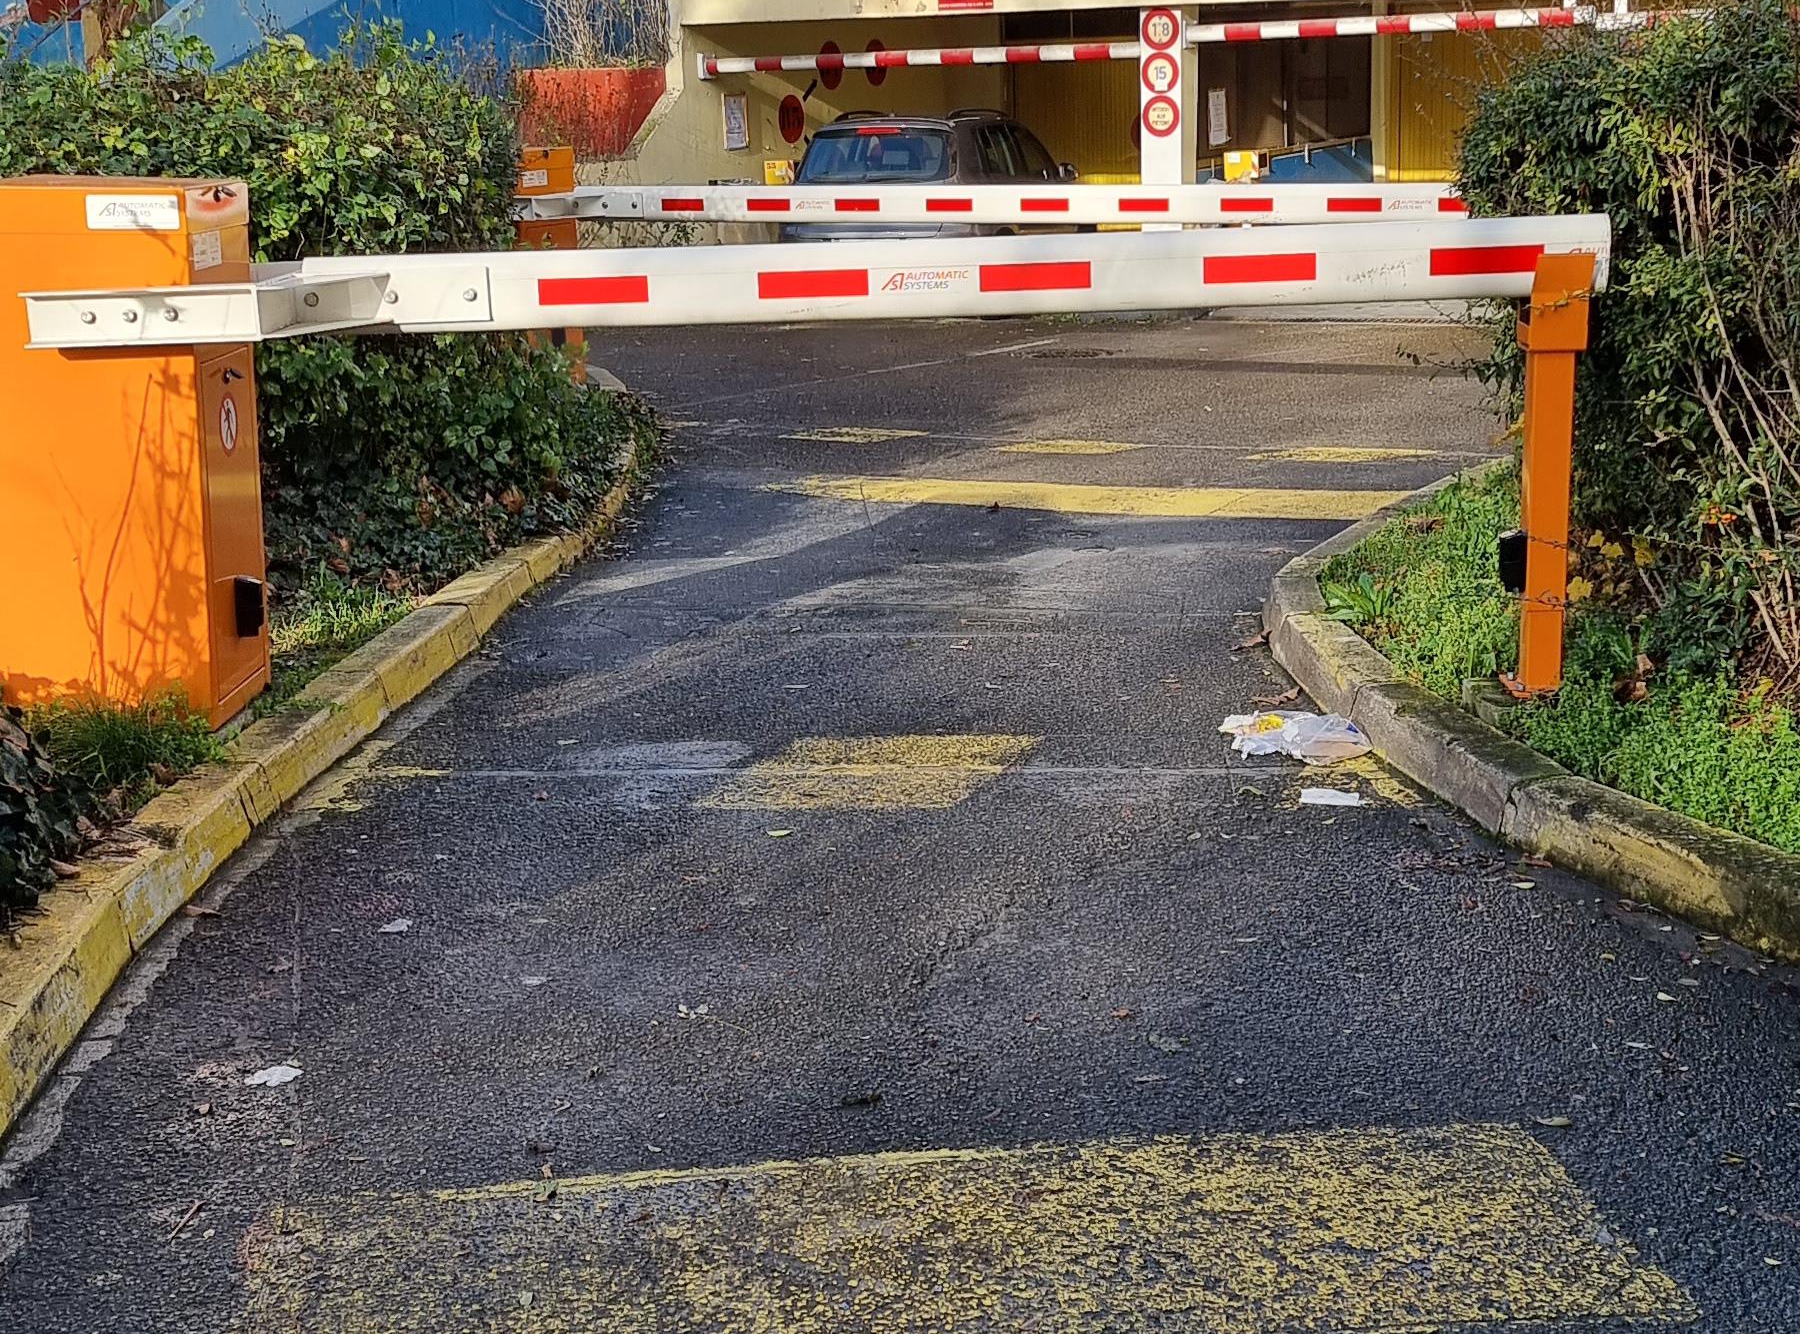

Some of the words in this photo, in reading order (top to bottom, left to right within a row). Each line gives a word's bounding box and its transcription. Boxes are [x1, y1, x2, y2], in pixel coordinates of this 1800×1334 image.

[1154, 66, 1167, 81] 15
[118, 202, 166, 210] AUTOMATIC
[905, 270, 968, 281] AUTOMATIC
[904, 280, 949, 291] SYSTEMS
